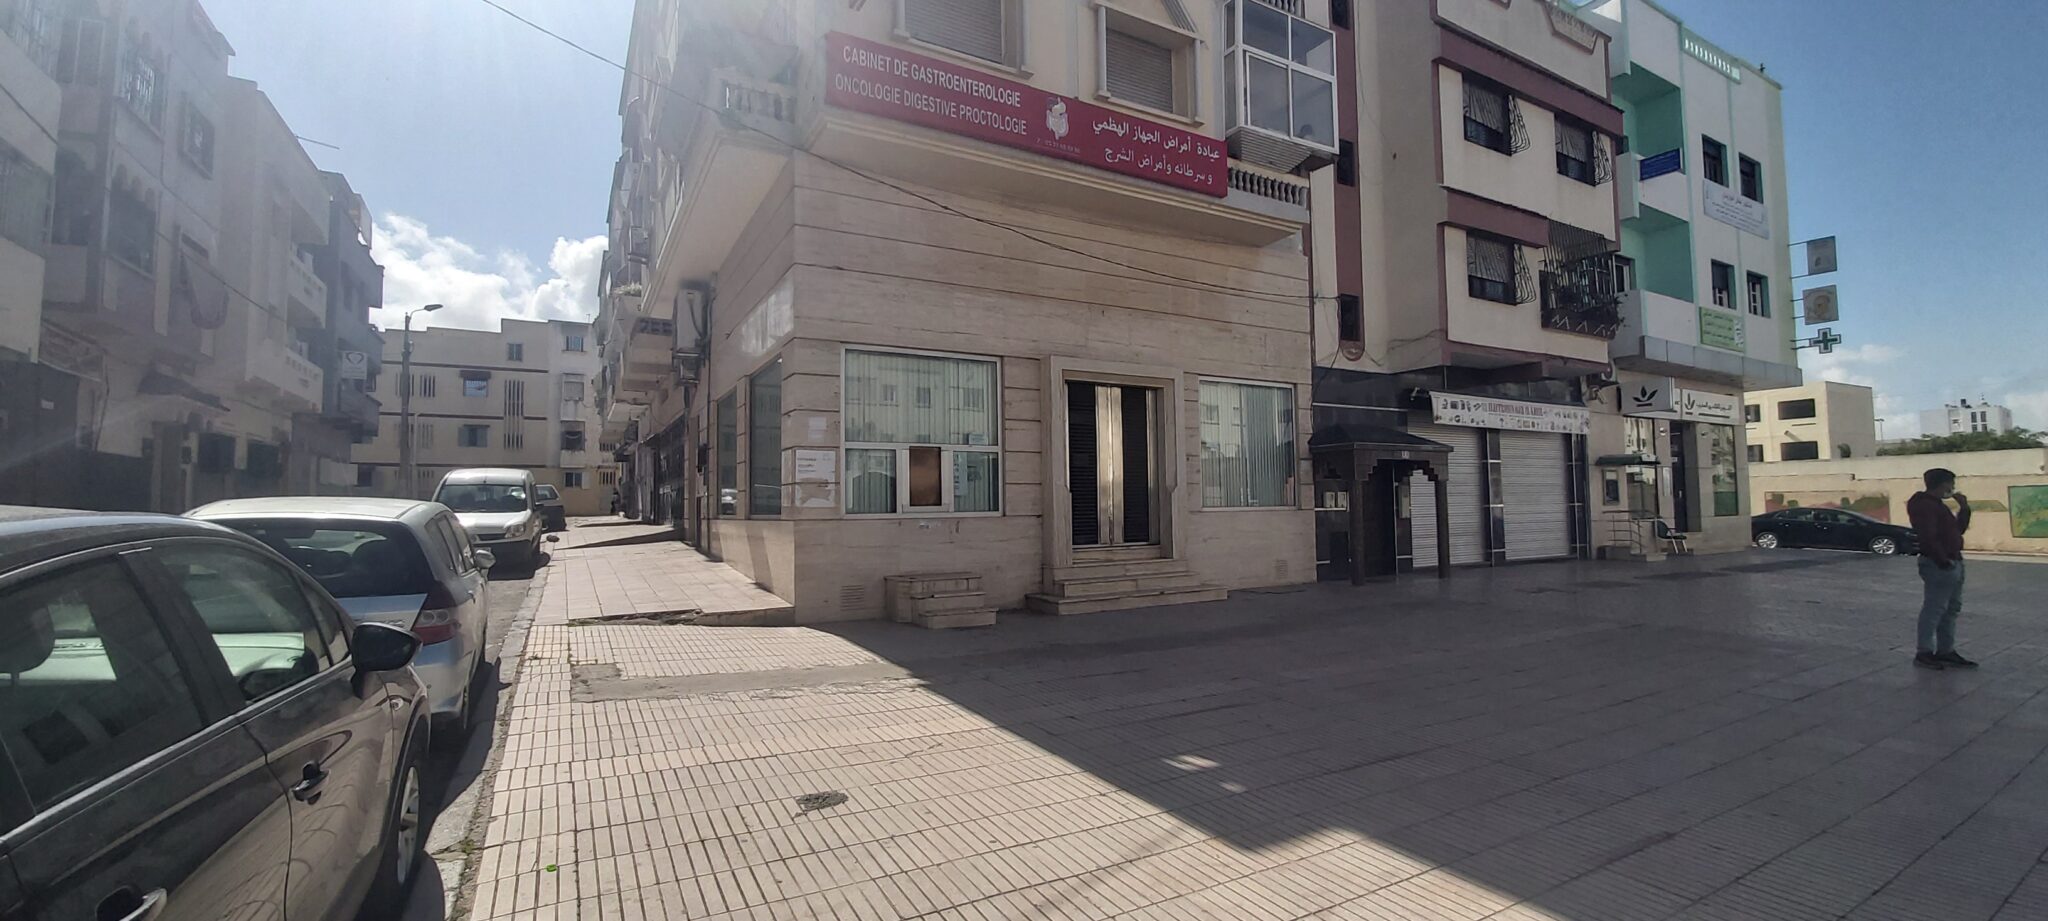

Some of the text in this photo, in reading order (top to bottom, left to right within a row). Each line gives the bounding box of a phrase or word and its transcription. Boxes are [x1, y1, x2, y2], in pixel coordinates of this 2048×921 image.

[843, 46, 1021, 107] CABINET DE GASTROENTEROLOGIE
[835, 73, 1027, 135] ONCOLOGIE DIGESTIVE PROCTOLOGIE
[1132, 126, 1160, 144] الجهاز
[1163, 136, 1191, 153] أمراض
[1104, 146, 1134, 163] الشرج
[1196, 142, 1220, 162] عيادة
